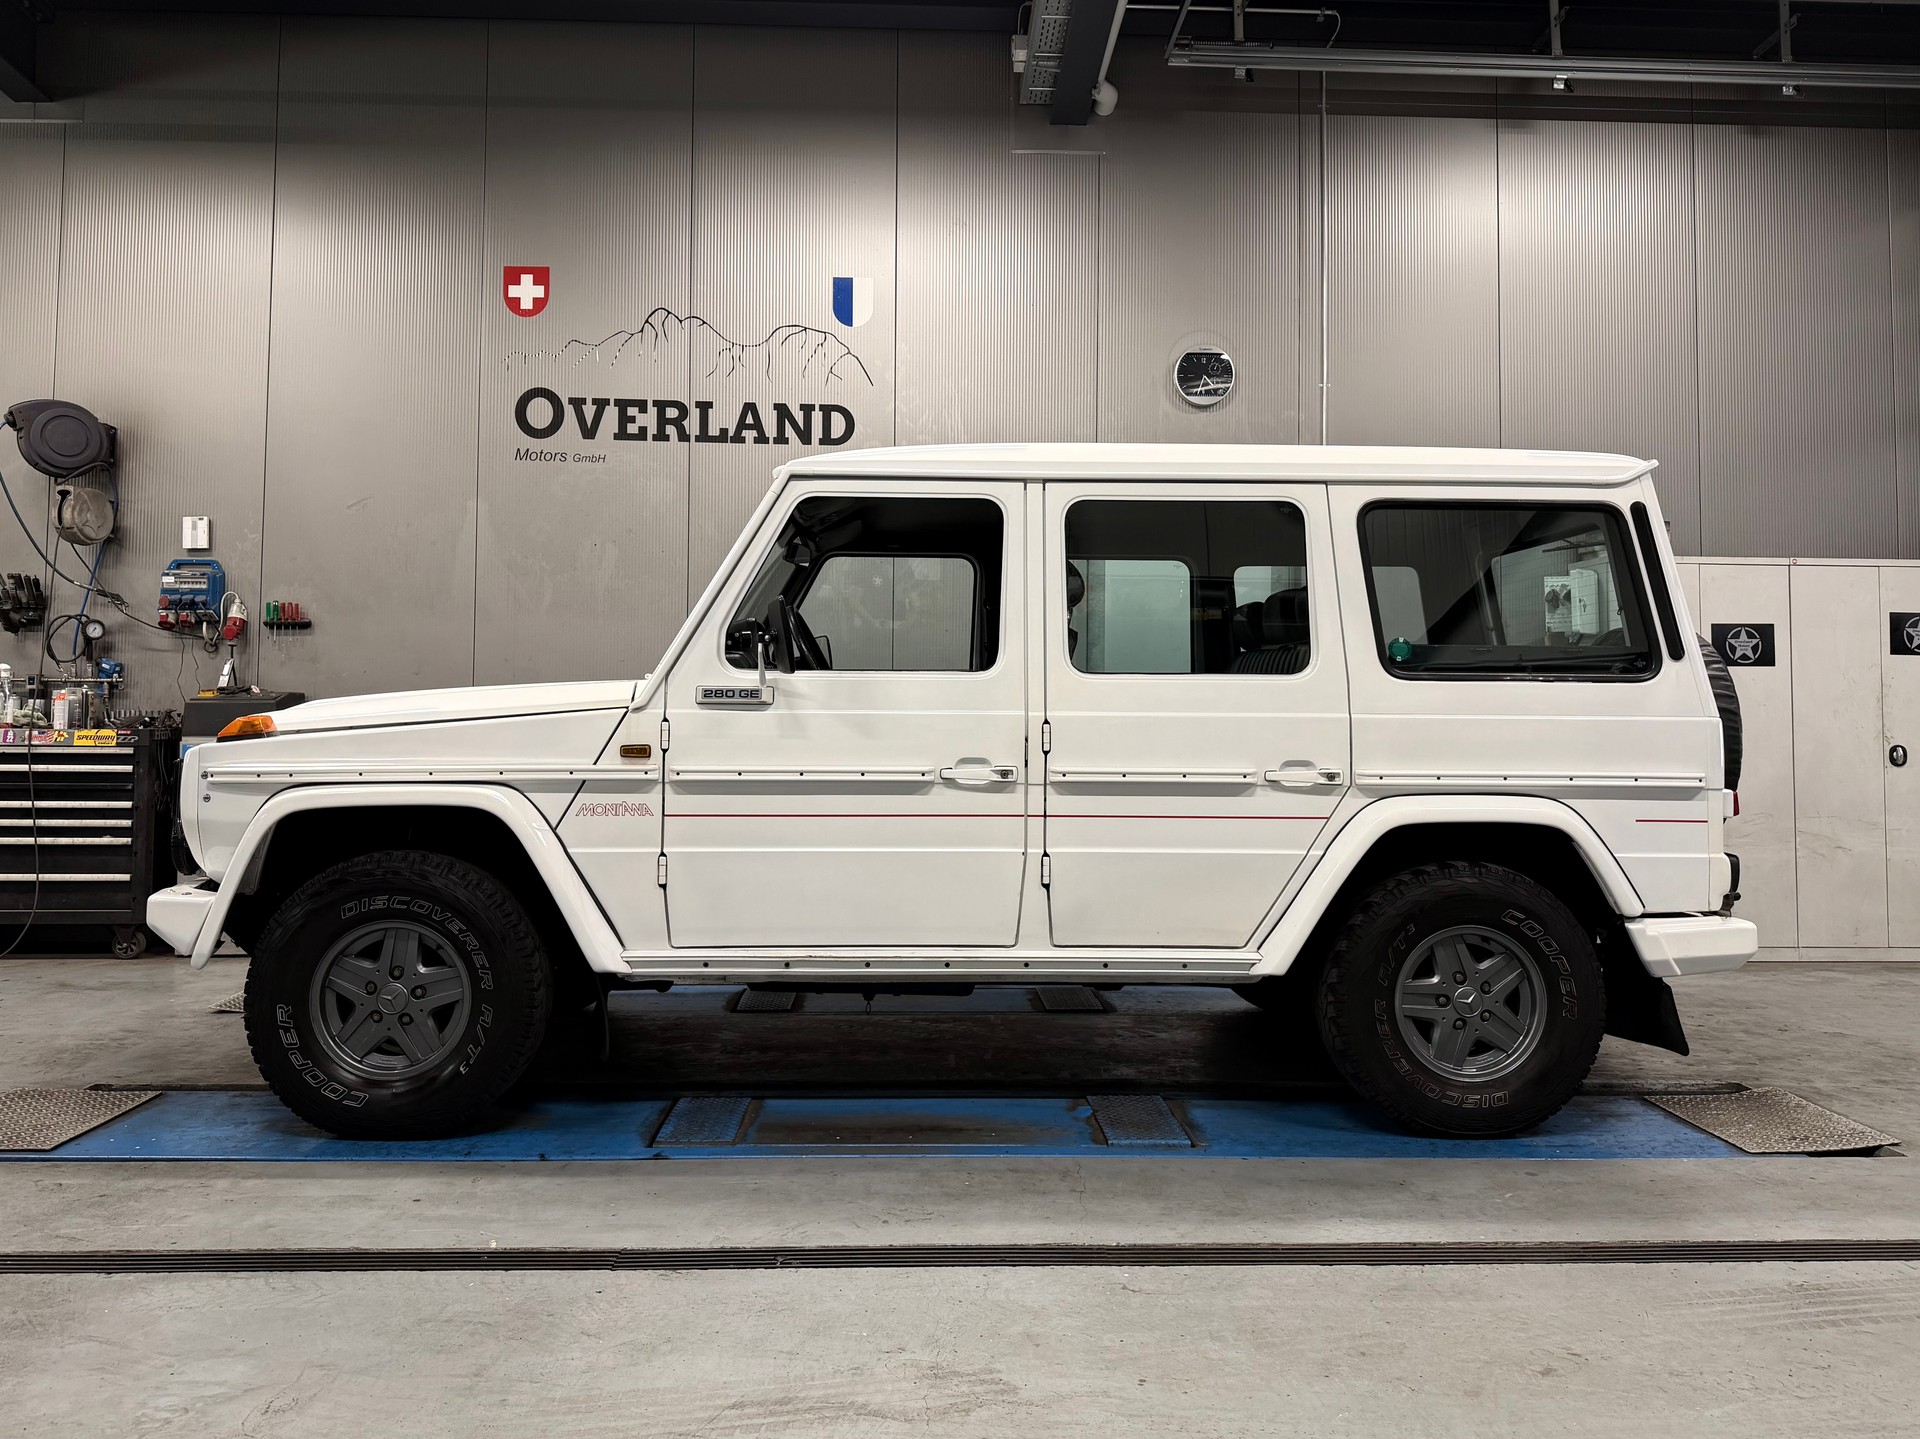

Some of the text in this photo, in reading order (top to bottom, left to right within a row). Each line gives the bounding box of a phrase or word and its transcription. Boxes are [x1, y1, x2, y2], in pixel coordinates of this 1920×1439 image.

[515, 387, 855, 446] OVERLAND
[514, 447, 607, 464] Motors GmbH
[703, 689, 760, 698] 280 GE
[76, 734, 116, 742] SPEEDWAY
[575, 801, 654, 816] MONTANA
[340, 895, 494, 990] DISCOVERER
[1501, 909, 1578, 1020] COOPER
[276, 1004, 369, 1107] COOPER
[1375, 999, 1509, 1107] DISCOVERER
